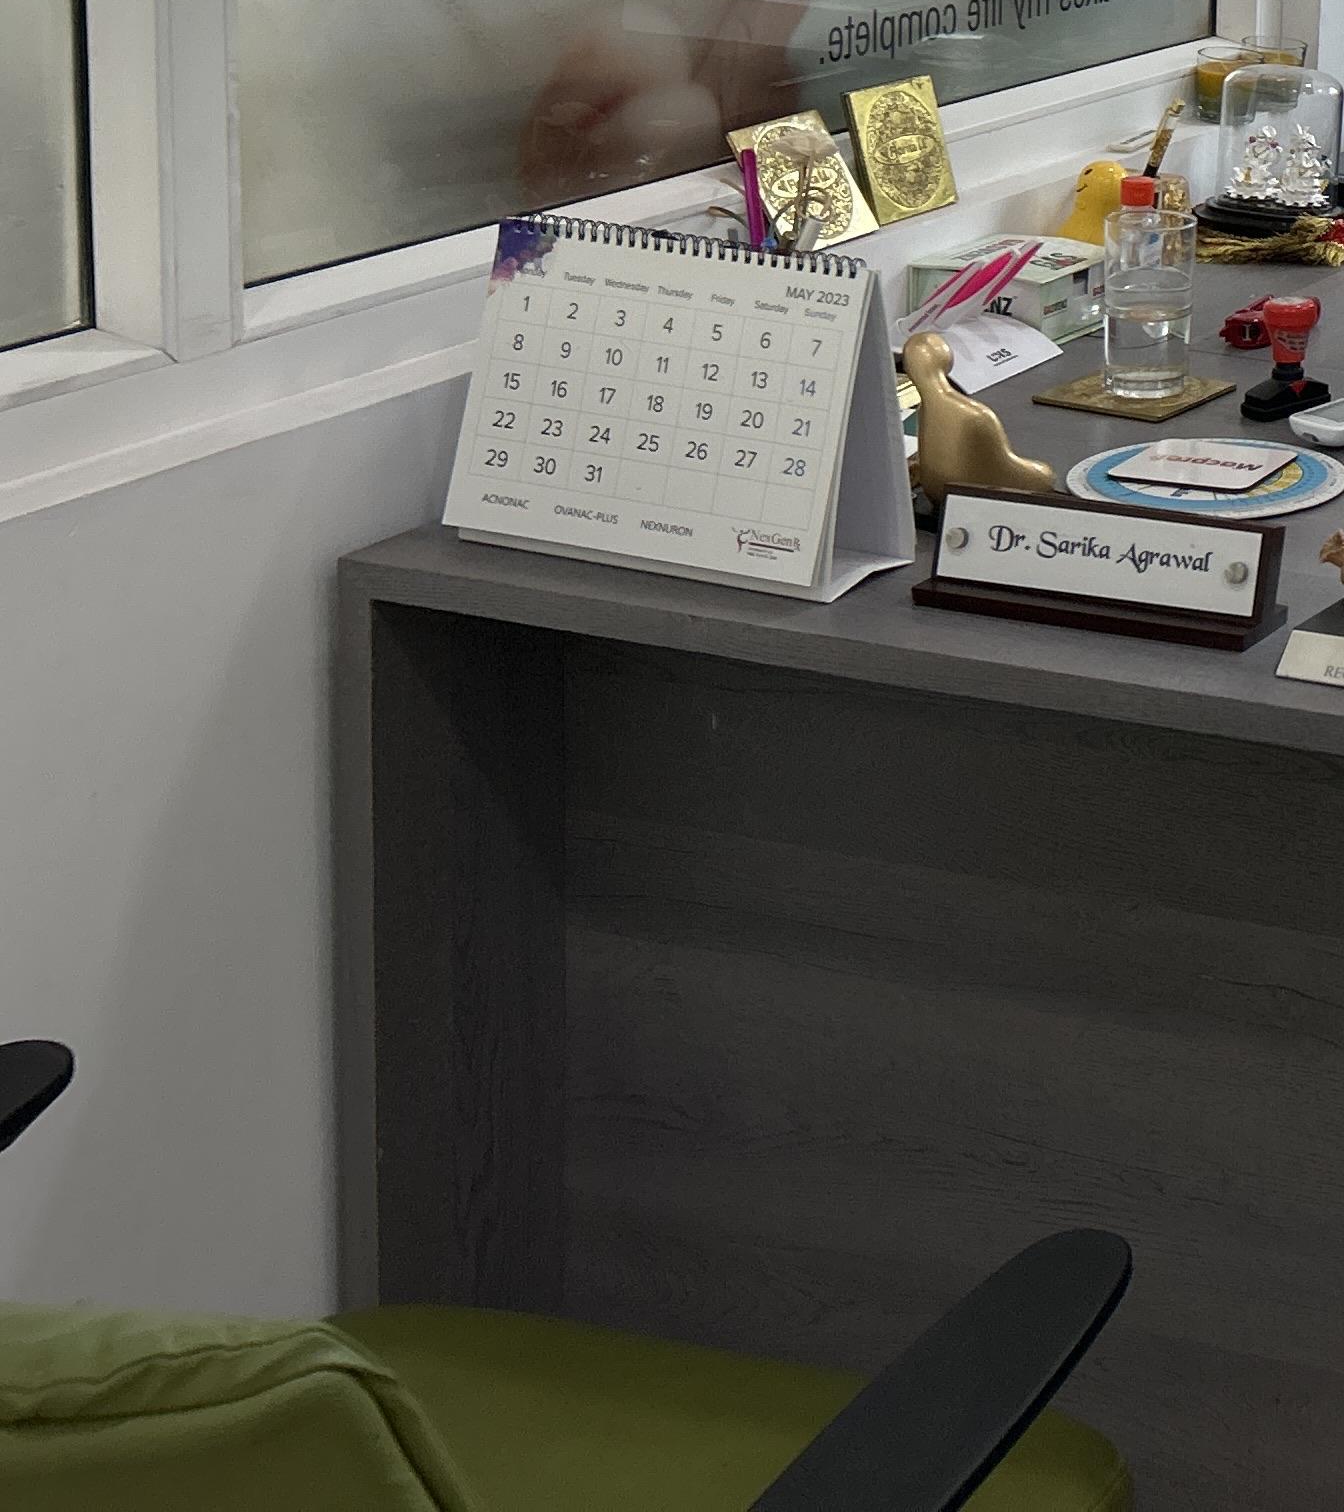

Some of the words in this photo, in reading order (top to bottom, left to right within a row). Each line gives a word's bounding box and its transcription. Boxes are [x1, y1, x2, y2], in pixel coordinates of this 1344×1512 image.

[563, 271, 596, 286] Tuesday
[657, 285, 694, 301] Thursday
[711, 293, 735, 307] Friday
[754, 299, 789, 315] Saturday
[804, 306, 837, 322] Sunday
[785, 285, 813, 302] MAY
[816, 290, 850, 307] 2023
[524, 296, 529, 311] 1
[567, 303, 578, 319] 2
[615, 310, 625, 326] 3
[663, 318, 673, 333] 4
[712, 324, 722, 341] 5
[761, 332, 770, 348] 6
[813, 340, 822, 356] 7
[513, 334, 524, 350] 8
[561, 342, 571, 358] 9
[606, 348, 622, 366] 10
[658, 357, 668, 373] 11
[703, 364, 719, 381] 12
[752, 371, 768, 389] 13
[800, 379, 815, 396] 14
[504, 373, 520, 390] 15
[552, 381, 567, 398] 16
[600, 388, 616, 404] 17
[648, 395, 664, 412] 18
[697, 403, 712, 420] 19
[741, 410, 763, 428] 20
[792, 419, 810, 436] 21
[485, 449, 508, 467] 29
[534, 457, 556, 475] 30
[585, 465, 602, 482] 31
[493, 411, 515, 429] 22
[541, 419, 563, 436] 23
[589, 426, 610, 444] 24
[637, 433, 659, 452] 25
[686, 441, 708, 460] 26
[735, 450, 757, 467] 27
[783, 458, 806, 476] 28
[988, 524, 1031, 553] Dr.
[1036, 531, 1111, 559] Sarika
[1115, 543, 1214, 574] Agrawal
